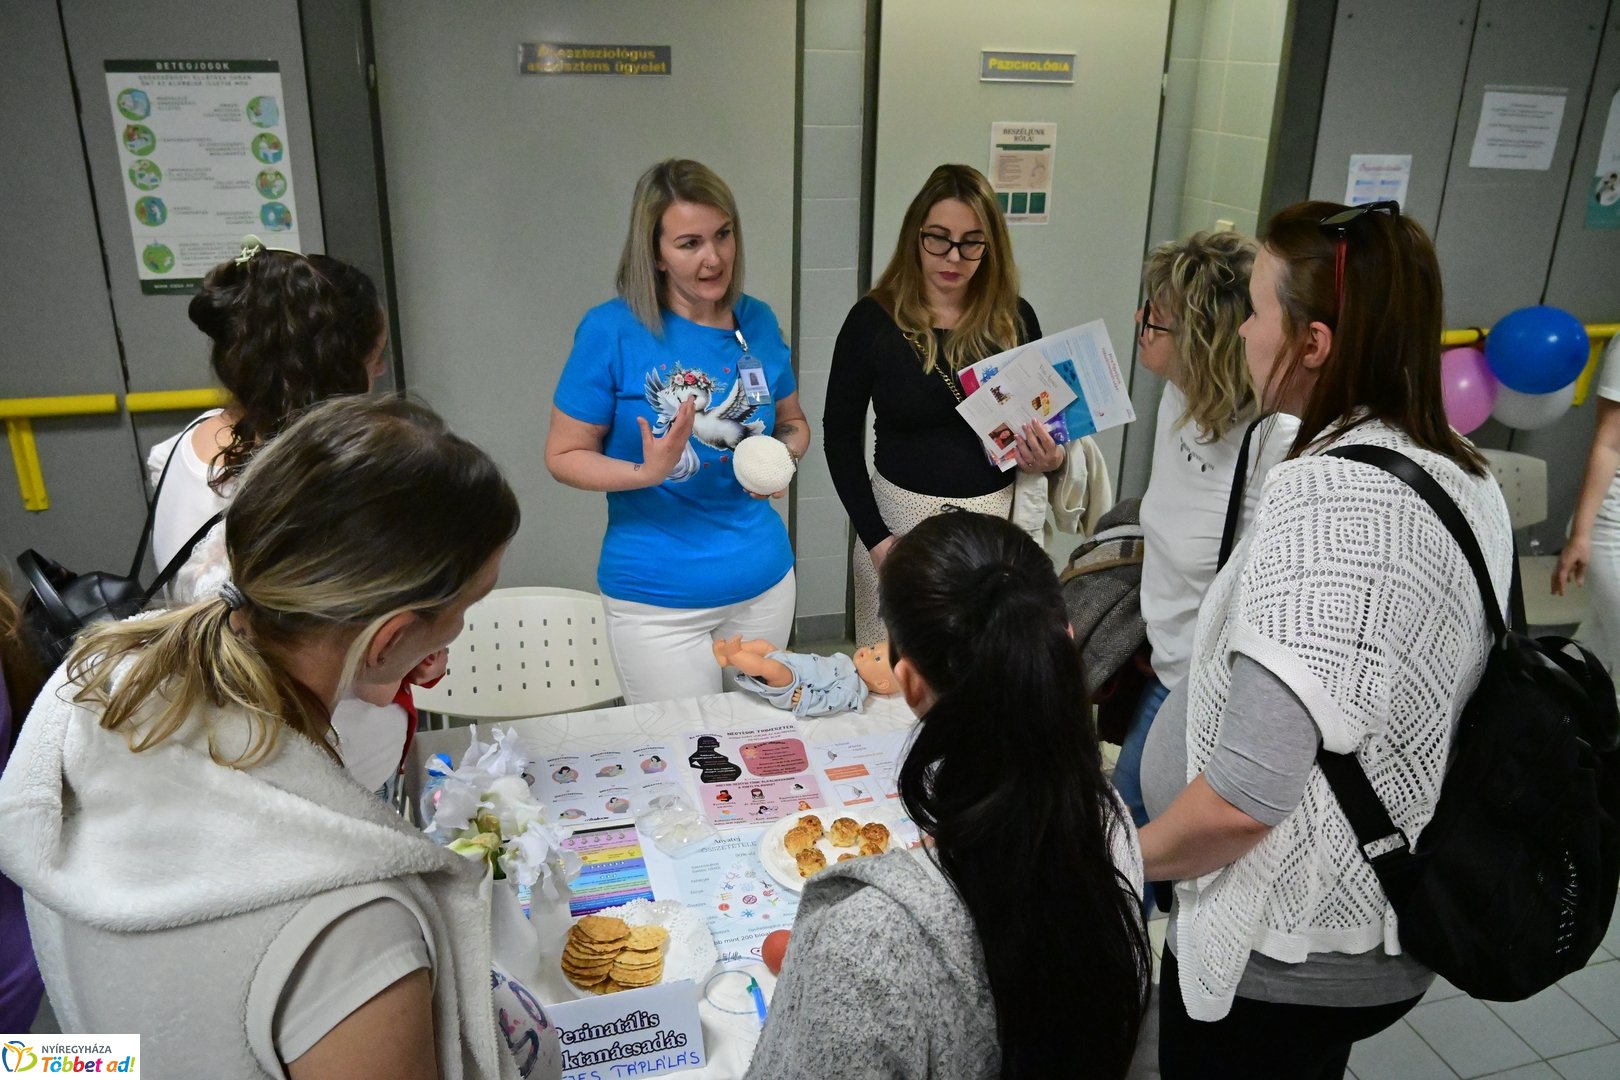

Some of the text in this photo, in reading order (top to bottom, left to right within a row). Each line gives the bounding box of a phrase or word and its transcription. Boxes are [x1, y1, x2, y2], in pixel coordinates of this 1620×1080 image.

[155, 61, 231, 71] BETEGJOGOK
[615, 61, 666, 75] ügyelet
[988, 57, 1070, 71] PSZICHOLÓGIA
[1003, 127, 1045, 136] BESZÉLJÜNK
[724, 936, 740, 944] mint
[741, 934, 754, 942] 200
[561, 1030, 688, 1071] ktanácsadás
[609, 1051, 701, 1078] TÁPLÁLÁS
